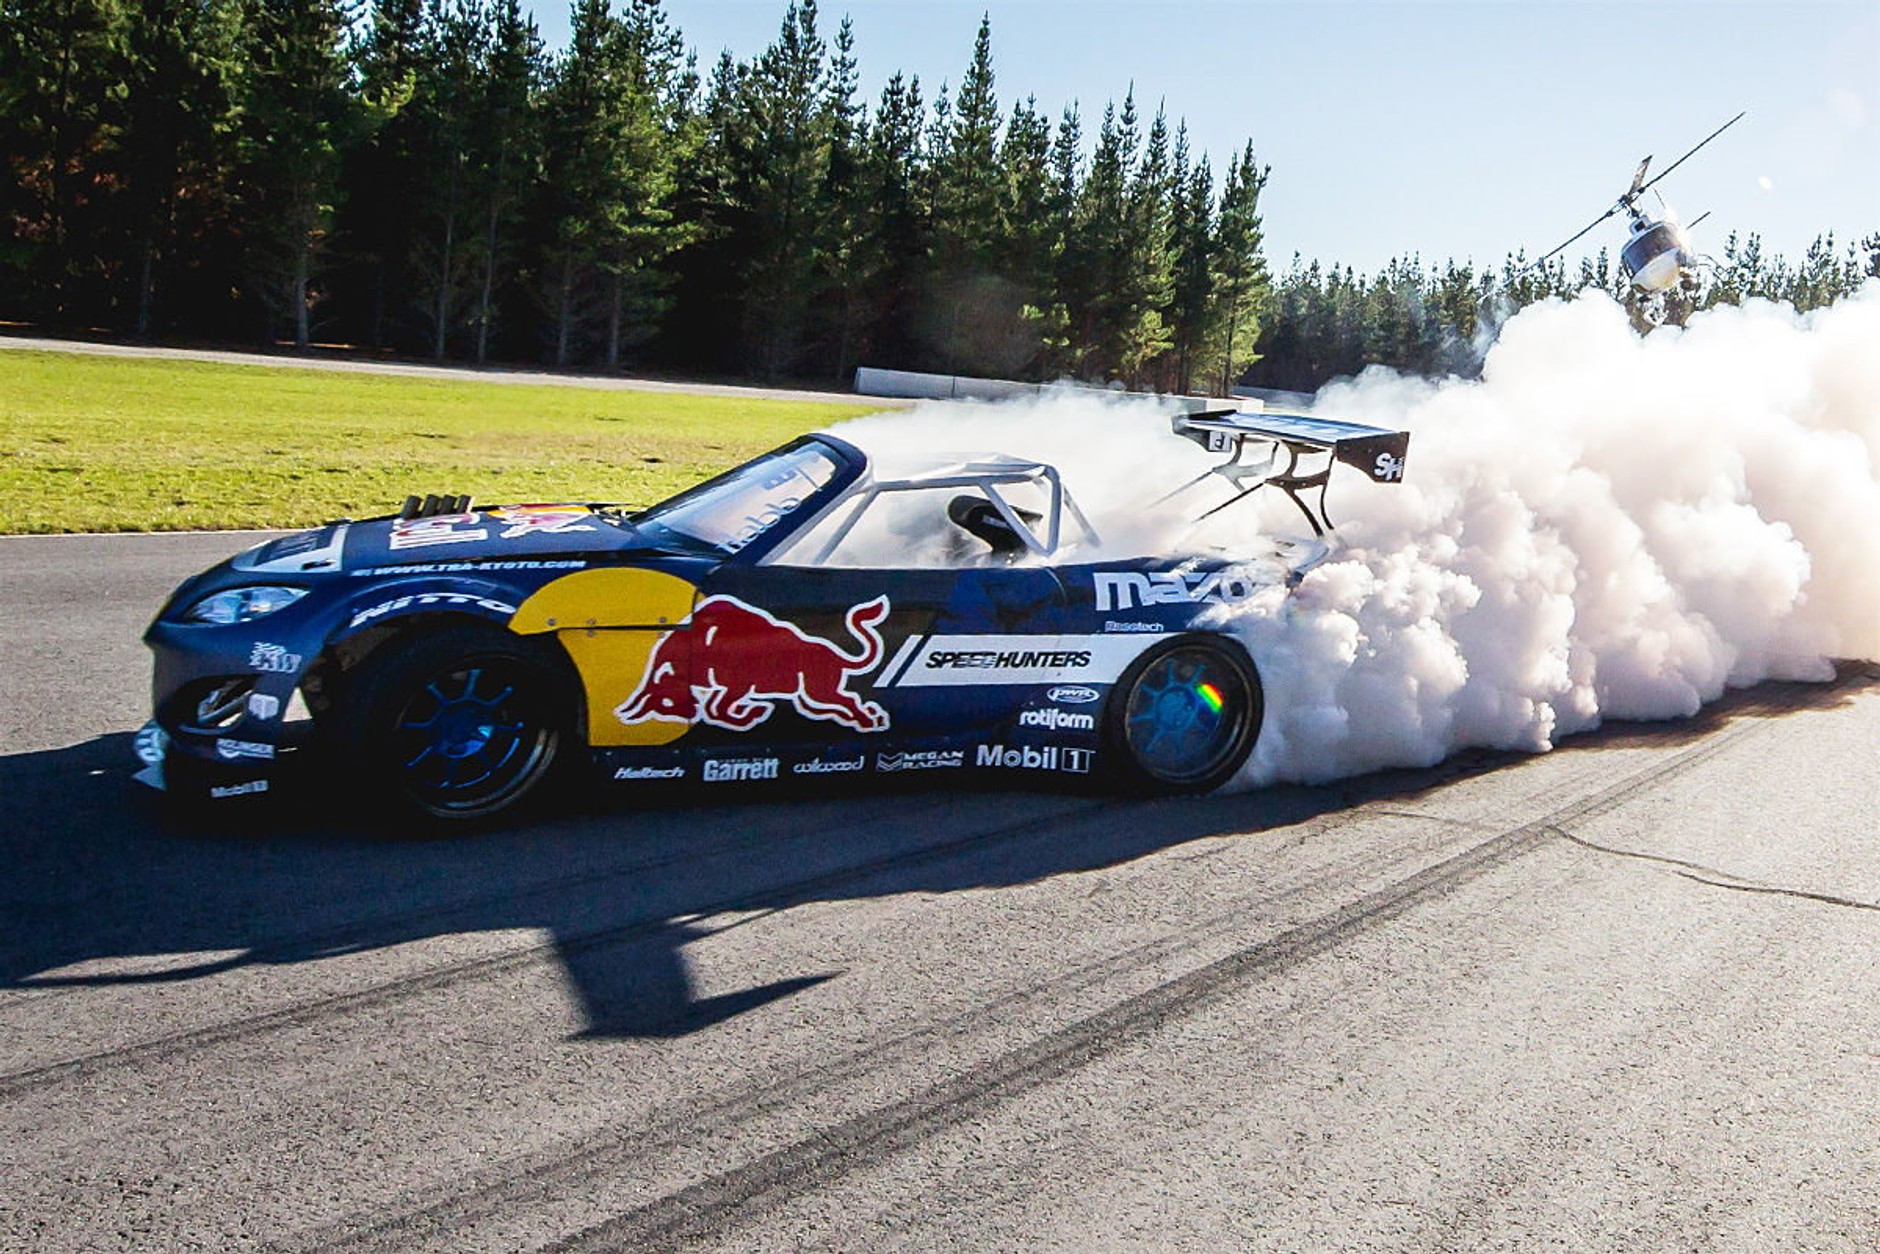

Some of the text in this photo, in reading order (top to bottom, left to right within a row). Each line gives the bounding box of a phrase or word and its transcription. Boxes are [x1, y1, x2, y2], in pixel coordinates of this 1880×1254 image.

[350, 593, 517, 628] NITTO
[1019, 708, 1094, 730] rotiform
[902, 759, 963, 770] RACING
[903, 751, 965, 760] MEGAN
[976, 744, 1058, 770] Mobil
[614, 766, 685, 779] Haltech
[703, 757, 779, 782] Garrett
